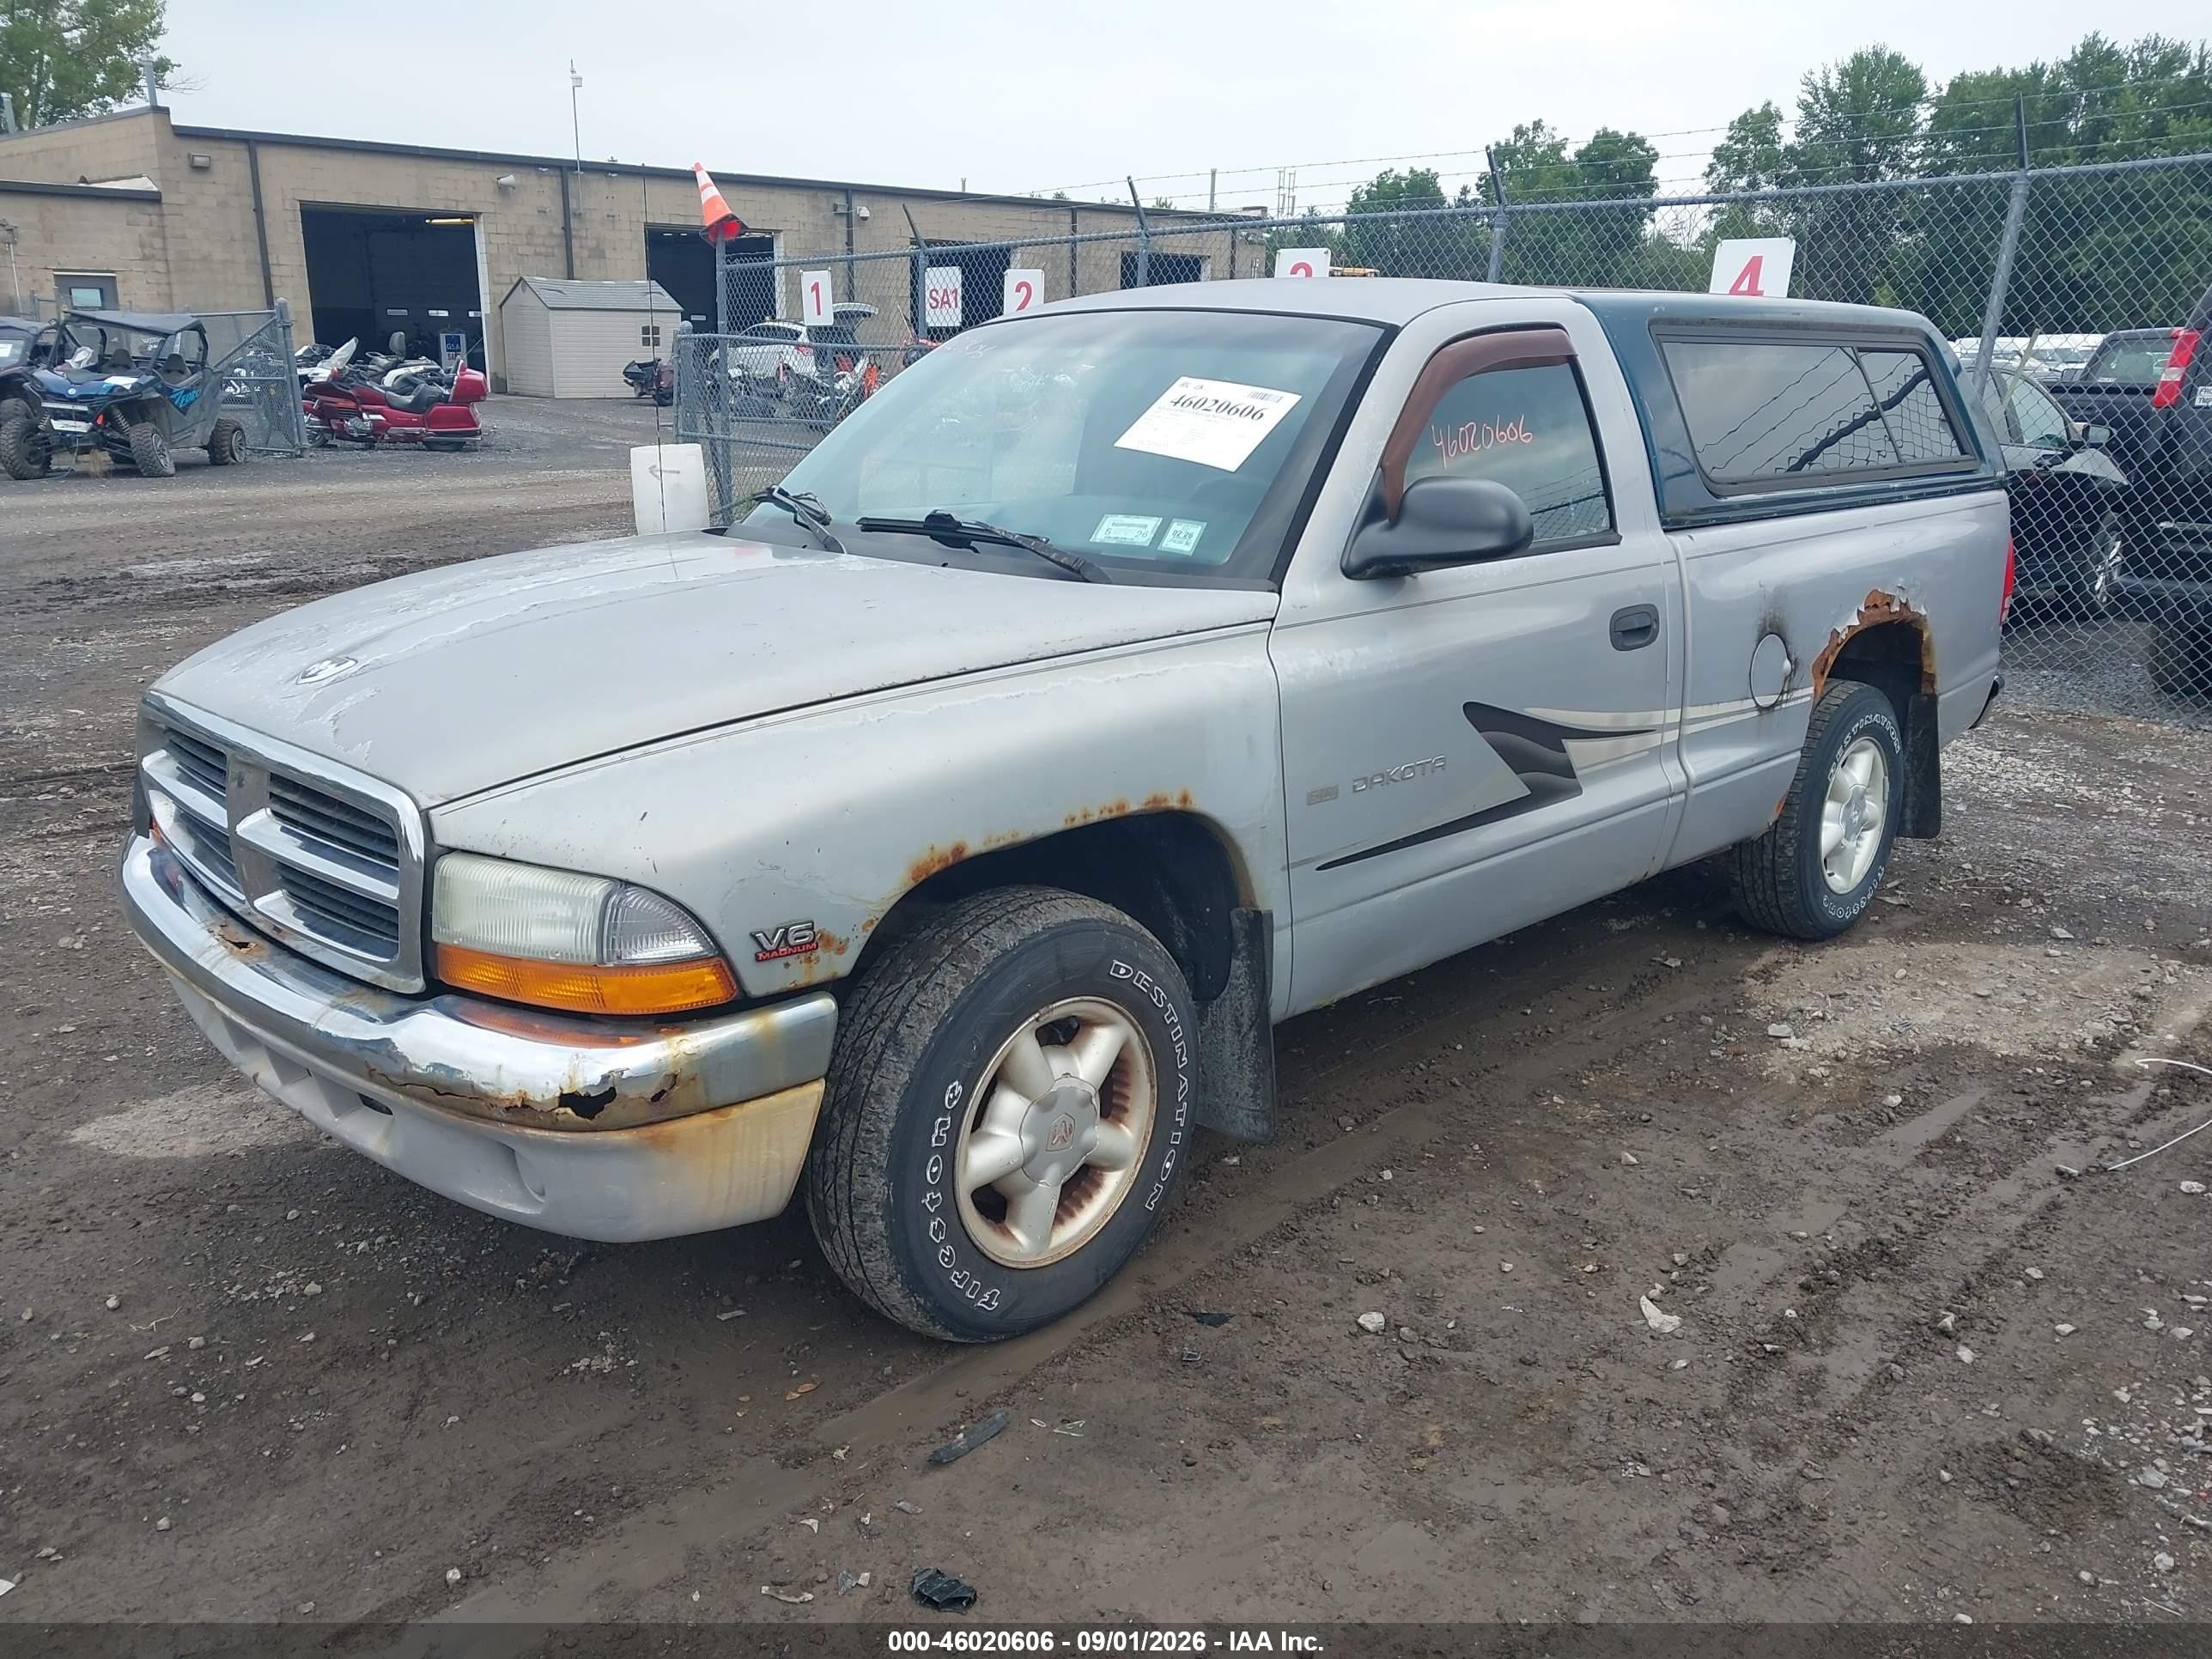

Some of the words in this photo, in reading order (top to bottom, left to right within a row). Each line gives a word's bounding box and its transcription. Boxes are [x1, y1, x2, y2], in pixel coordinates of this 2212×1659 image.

[1729, 255, 1765, 296] 4
[810, 281, 822, 317] 1
[928, 288, 959, 310] SA1
[1014, 281, 1032, 312] 2
[1170, 394, 1270, 421] 46020606
[1431, 414, 1534, 470] 46020606
[1827, 714, 1901, 783] DESTINATION
[1352, 754, 1446, 793] DAKOTA
[751, 921, 815, 951] V6
[757, 942, 817, 961] MAGNUM
[1109, 959, 1189, 1212] DESTINATION
